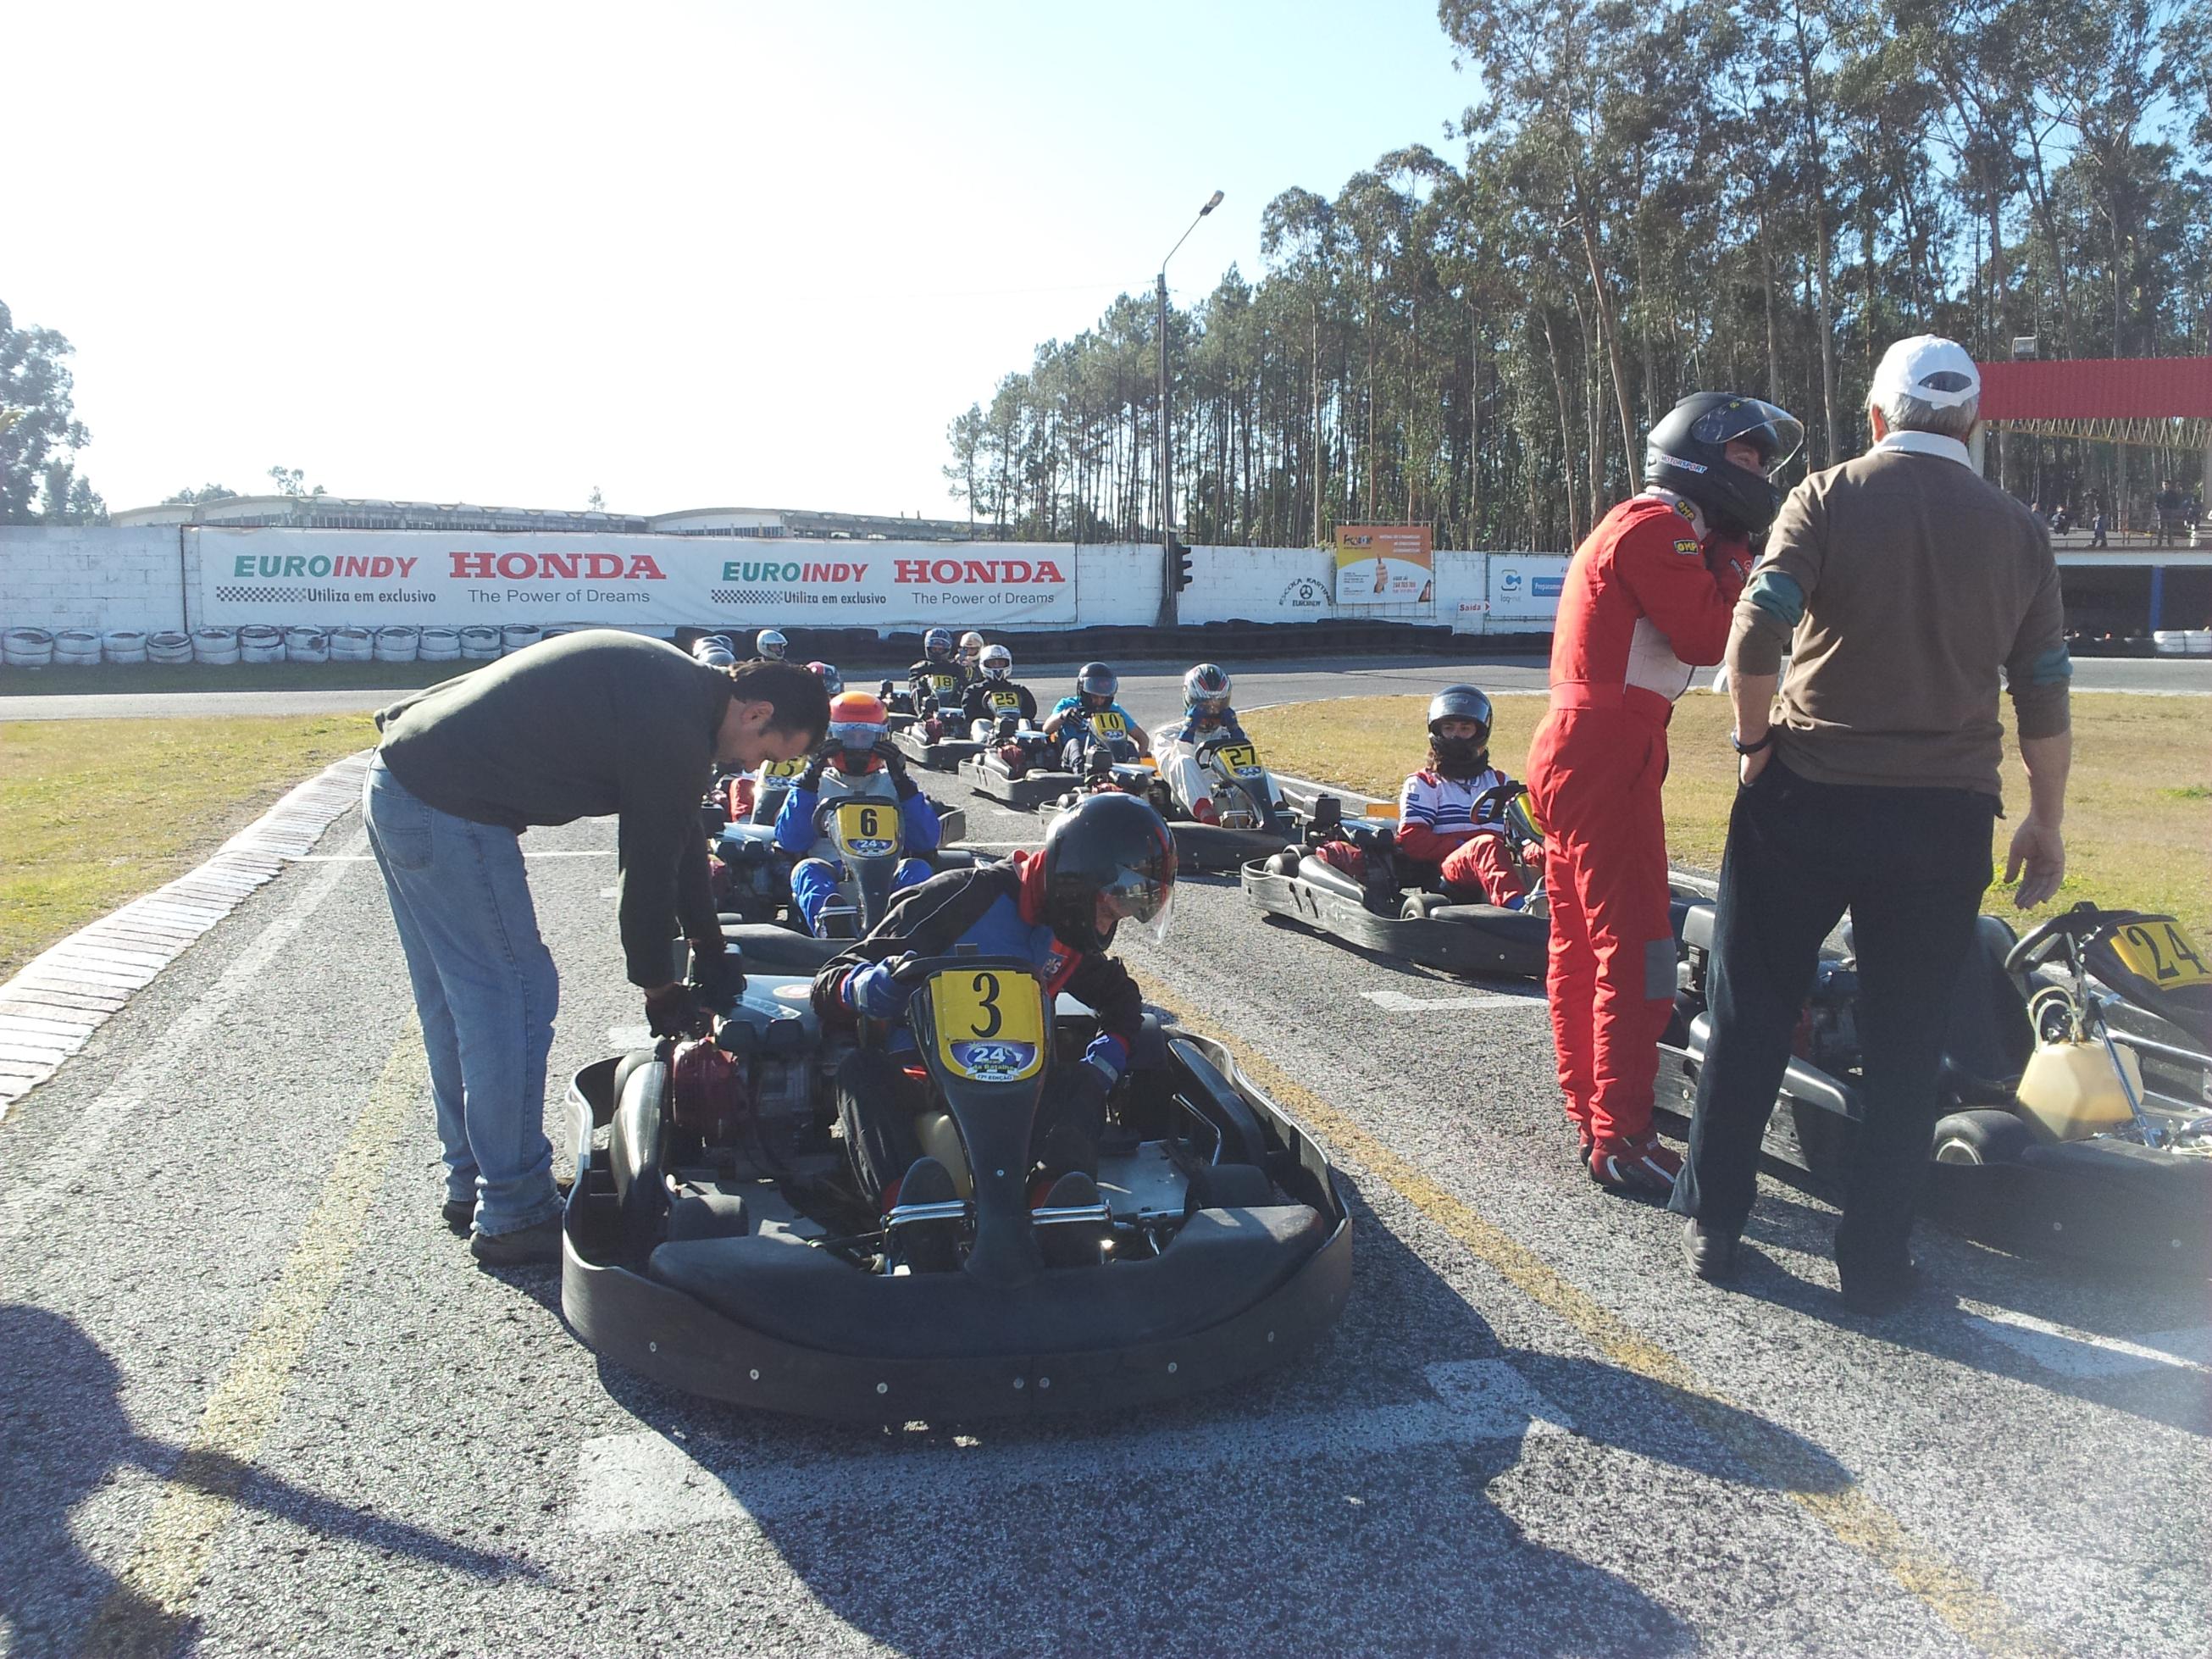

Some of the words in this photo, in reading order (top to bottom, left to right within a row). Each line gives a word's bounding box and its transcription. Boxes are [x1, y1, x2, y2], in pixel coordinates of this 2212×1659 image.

[1660, 454, 1708, 474] MOTORSPORT
[1677, 500, 1695, 520] OMP
[1677, 541, 1698, 552] OMP
[234, 555, 419, 578] EUROINDY
[449, 552, 667, 580] HONDA
[722, 561, 868, 583] EUROINDY
[894, 559, 1066, 584] HONDA
[308, 588, 350, 602] Utiliza
[354, 592, 374, 602] em
[379, 588, 436, 602] exclusivo
[468, 590, 501, 602] The
[507, 590, 561, 602] Power
[566, 590, 582, 602] of
[587, 590, 651, 603] Dreams
[784, 591, 818, 604] Utiliza
[822, 595, 838, 604] em
[840, 591, 886, 604] exclusivo
[911, 592, 937, 604] The
[942, 592, 984, 604] Power
[989, 592, 1001, 604] of
[1005, 592, 1054, 604] Dreams
[1278, 578, 1303, 606] ESCOLA
[937, 676, 952, 687] 18
[995, 693, 1016, 706] 25
[1099, 713, 1119, 730] 10
[1225, 746, 1256, 767] 27
[768, 757, 798, 777] 15
[861, 807, 878, 837] 6
[861, 840, 878, 848] 24
[2126, 923, 2211, 979] 24
[970, 972, 1003, 1038] 3
[974, 1047, 1006, 1063] 24
